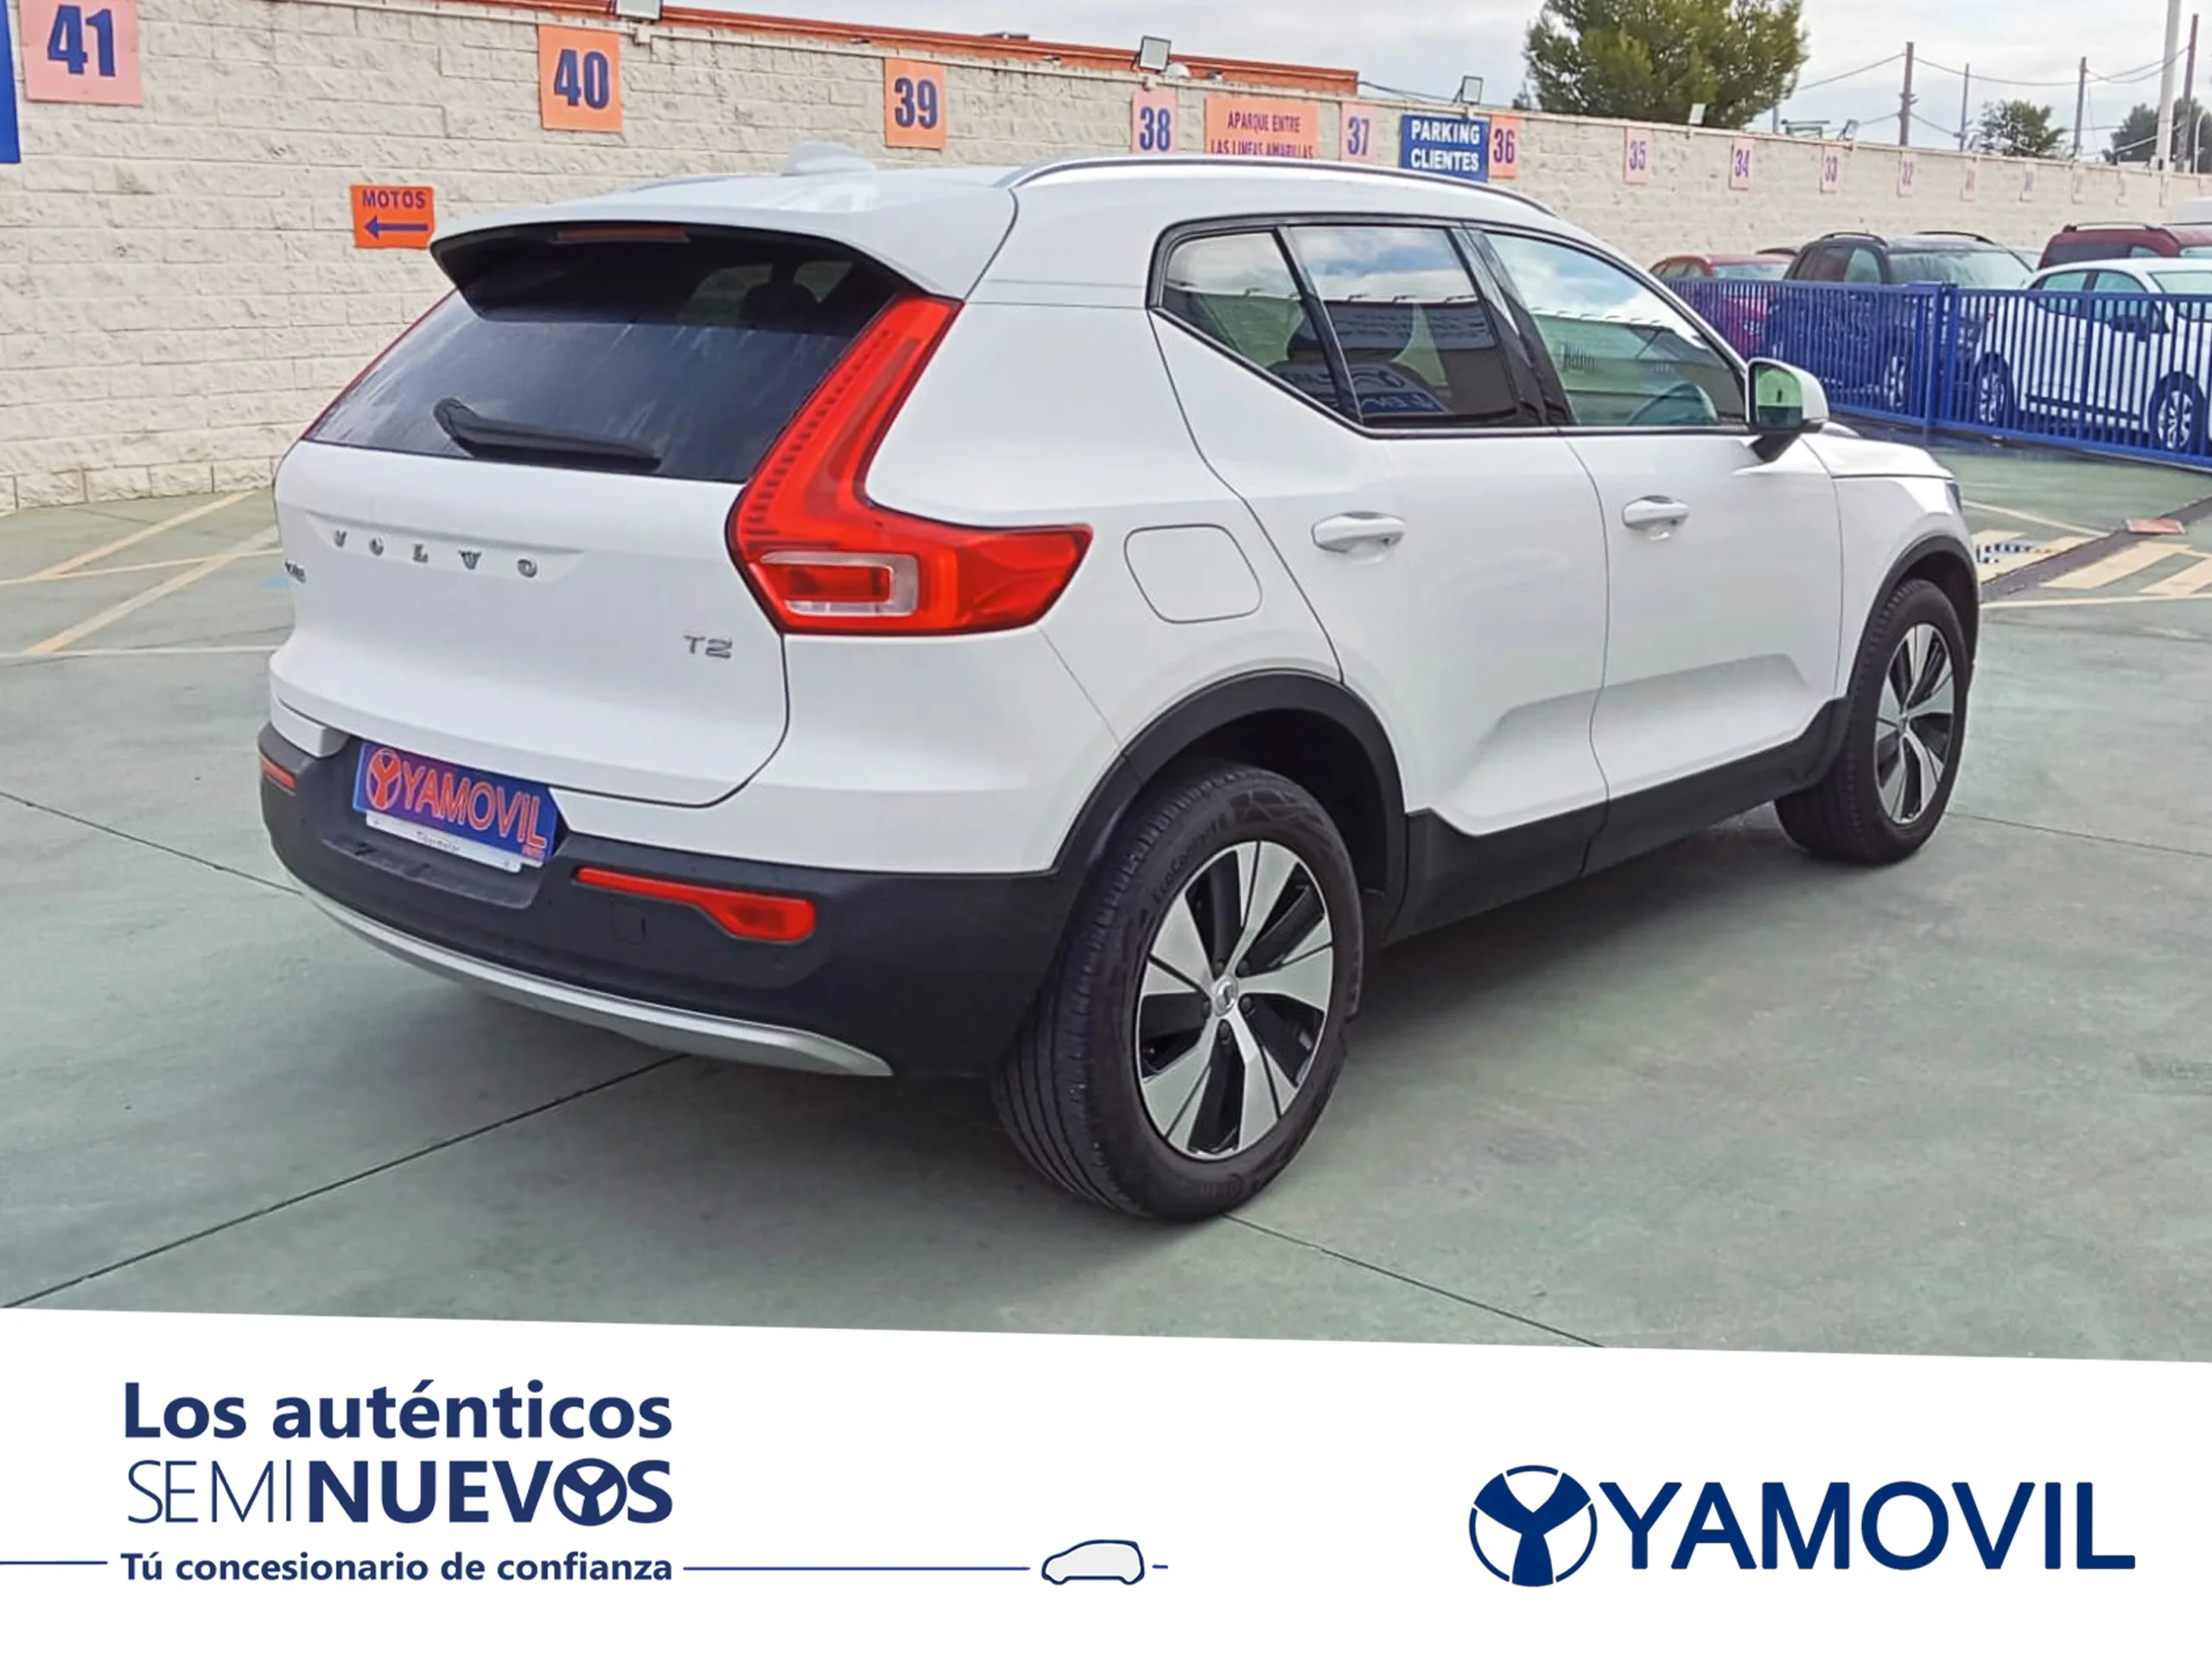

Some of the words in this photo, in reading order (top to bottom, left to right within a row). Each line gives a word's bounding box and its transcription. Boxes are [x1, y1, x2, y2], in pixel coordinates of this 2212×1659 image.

[47, 5, 115, 77] 41
[553, 49, 609, 108] 40
[894, 78, 938, 130] 39
[1139, 106, 1172, 152] 38
[1227, 111, 1268, 132] APARQUE
[1272, 114, 1301, 133] ENTRE
[1348, 116, 1370, 156] 37
[1411, 120, 1480, 145] PARKING
[1211, 139, 1229, 154] LAS
[1411, 150, 1479, 173] CLIENTES
[1493, 128, 1516, 164] 36
[1629, 140, 1646, 170] 35
[1734, 149, 1750, 178] 34
[361, 189, 426, 210] MOTOS
[334, 528, 538, 578] VOLVO
[683, 634, 733, 659] T2
[403, 760, 546, 849] YAMOVIL
